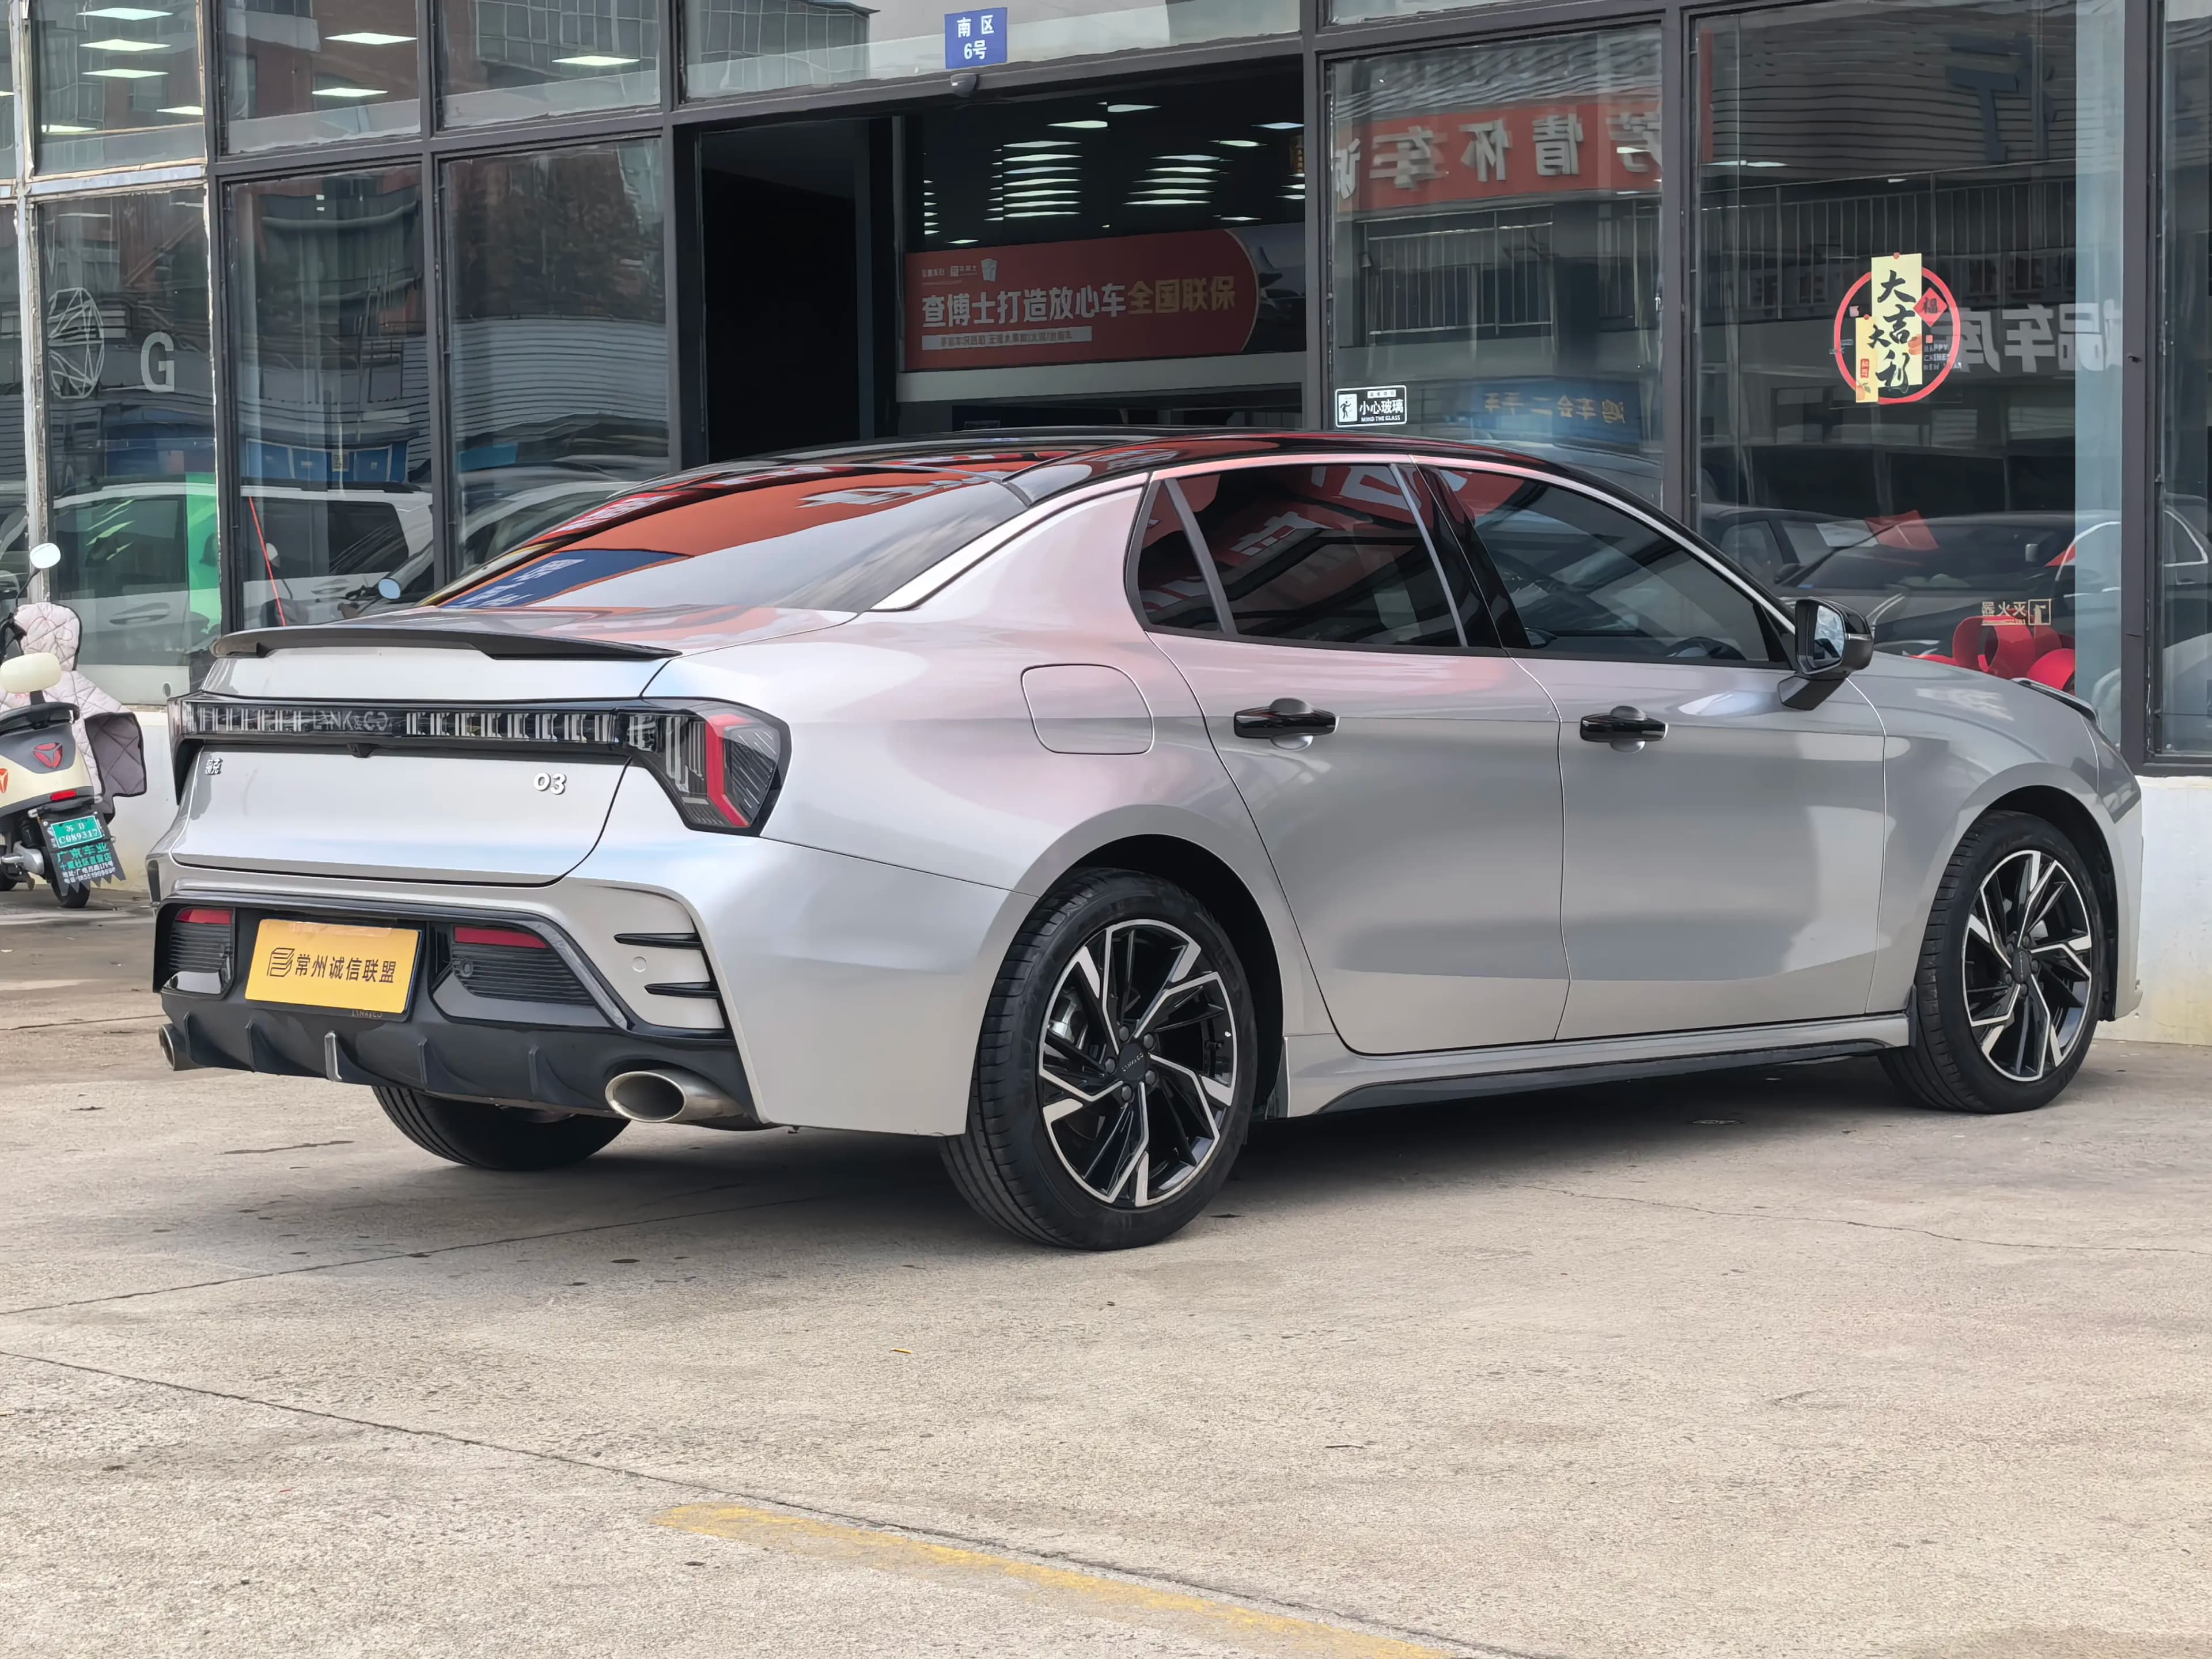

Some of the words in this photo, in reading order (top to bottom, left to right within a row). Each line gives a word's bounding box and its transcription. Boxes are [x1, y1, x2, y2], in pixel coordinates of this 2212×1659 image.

[957, 14, 994, 38] 南区
[964, 39, 987, 60] 6号
[141, 331, 175, 393] G
[1359, 399, 1404, 415] 小心玻璃
[533, 772, 567, 796] 03
[295, 953, 397, 984] 常州诚信联盟
